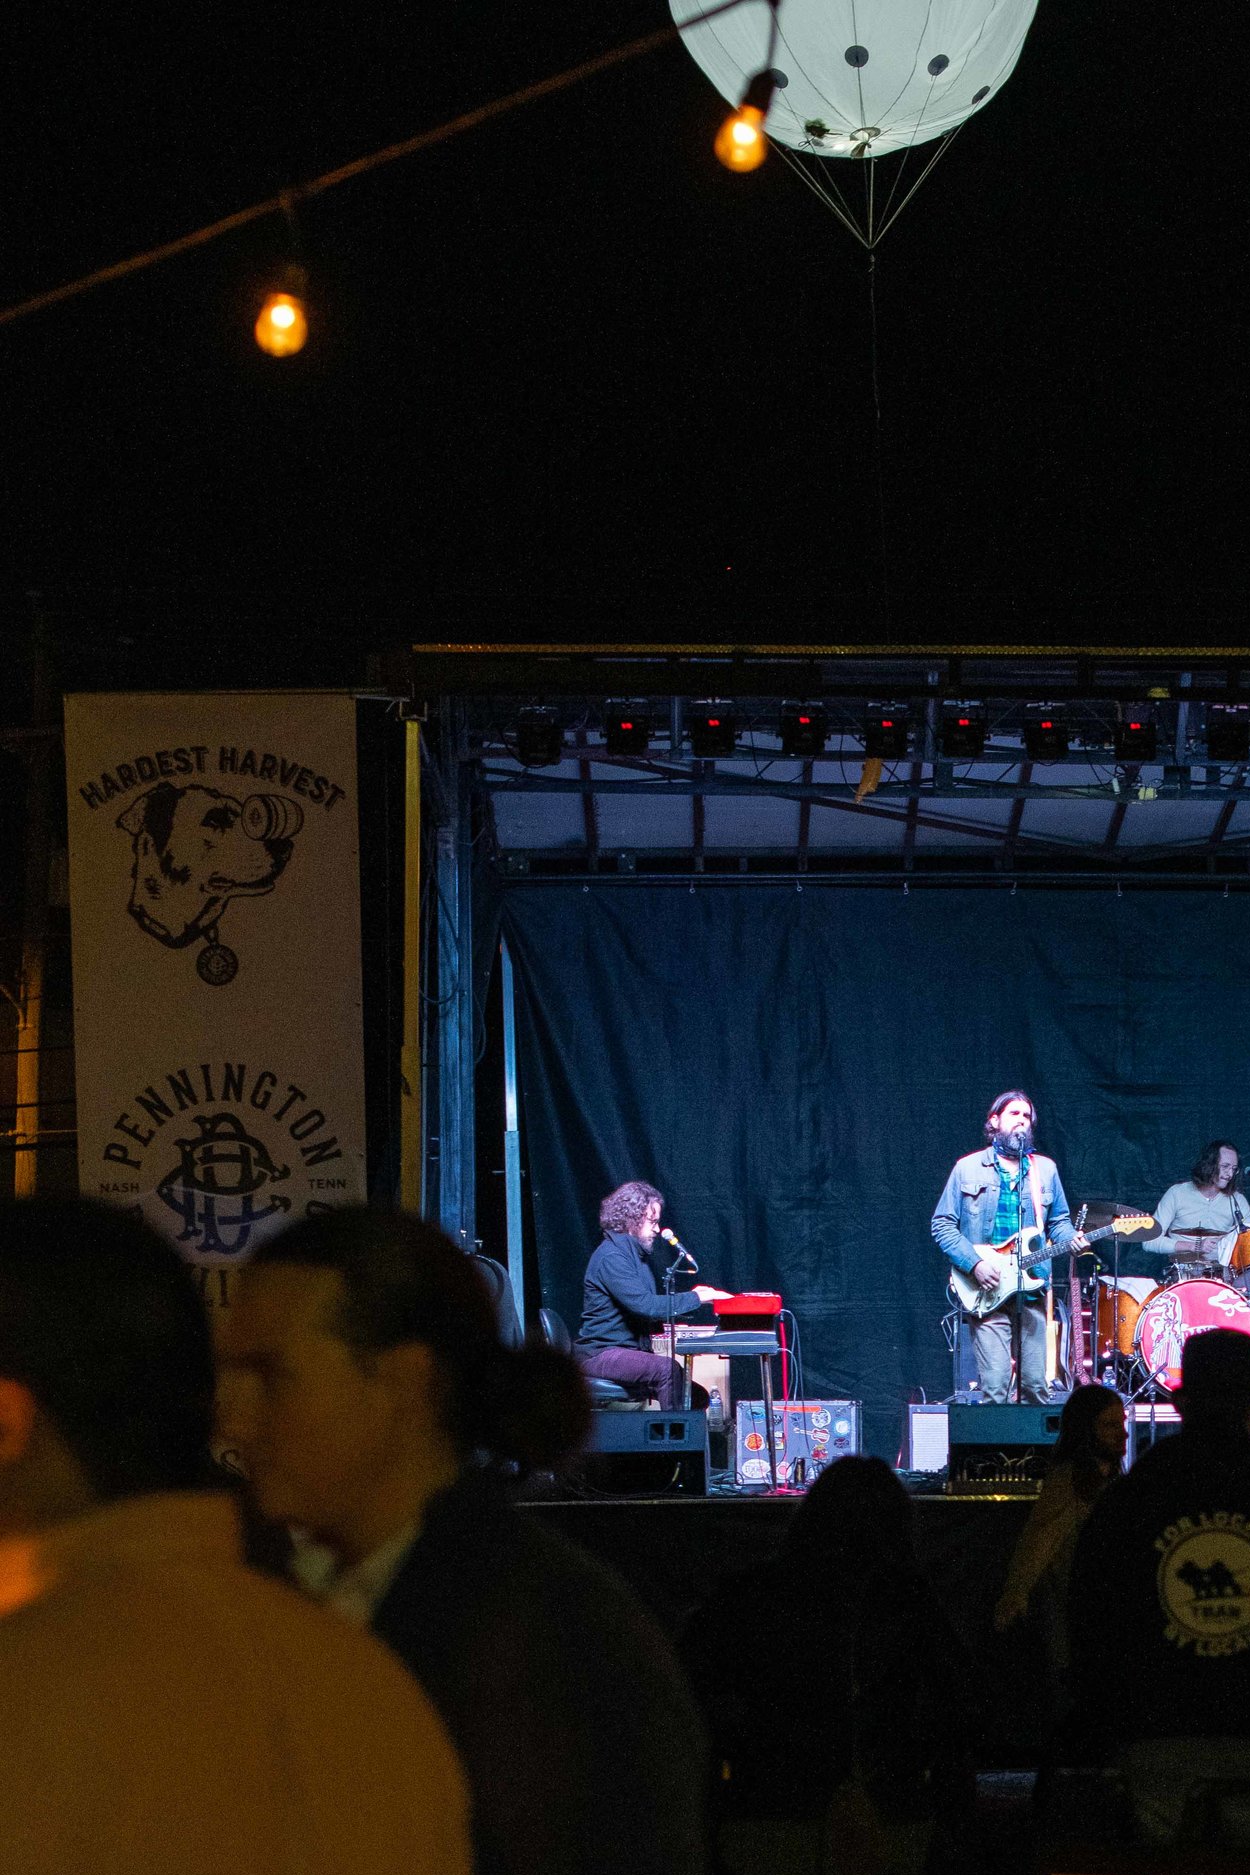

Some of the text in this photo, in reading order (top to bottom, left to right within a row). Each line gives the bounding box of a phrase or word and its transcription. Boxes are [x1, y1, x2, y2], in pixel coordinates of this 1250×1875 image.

[79, 746, 346, 813] HARDEST HARVEST
[103, 1062, 343, 1170] PENNINGTON
[100, 1182, 140, 1194] NASH
[308, 1178, 347, 1190] TENN
